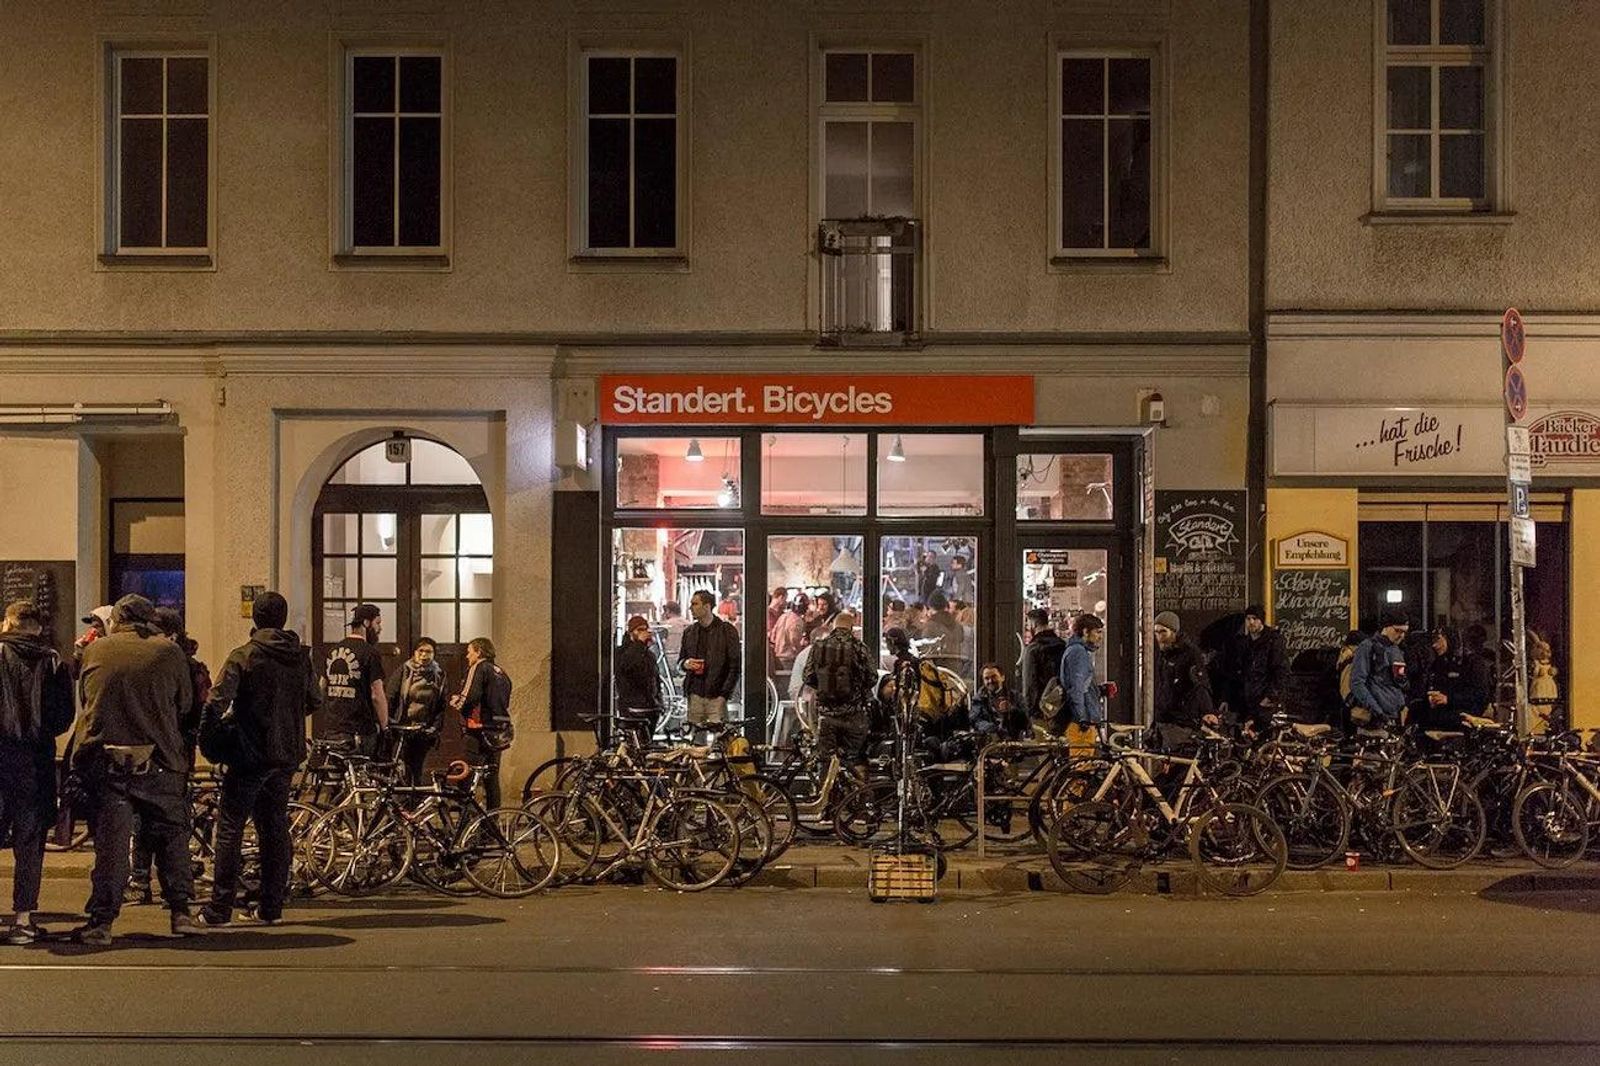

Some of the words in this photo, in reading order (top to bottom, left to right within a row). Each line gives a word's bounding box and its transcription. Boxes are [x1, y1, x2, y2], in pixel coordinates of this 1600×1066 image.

[613, 385, 755, 414] Standert.
[763, 385, 893, 419] Bicycles
[1414, 412, 1440, 436] die
[1545, 418, 1597, 433] Bäcker
[388, 443, 405, 455] 157
[1394, 424, 1462, 467] Frische!
[1296, 539, 1330, 549] Unsere
[1284, 549, 1342, 561] Empfehlung
